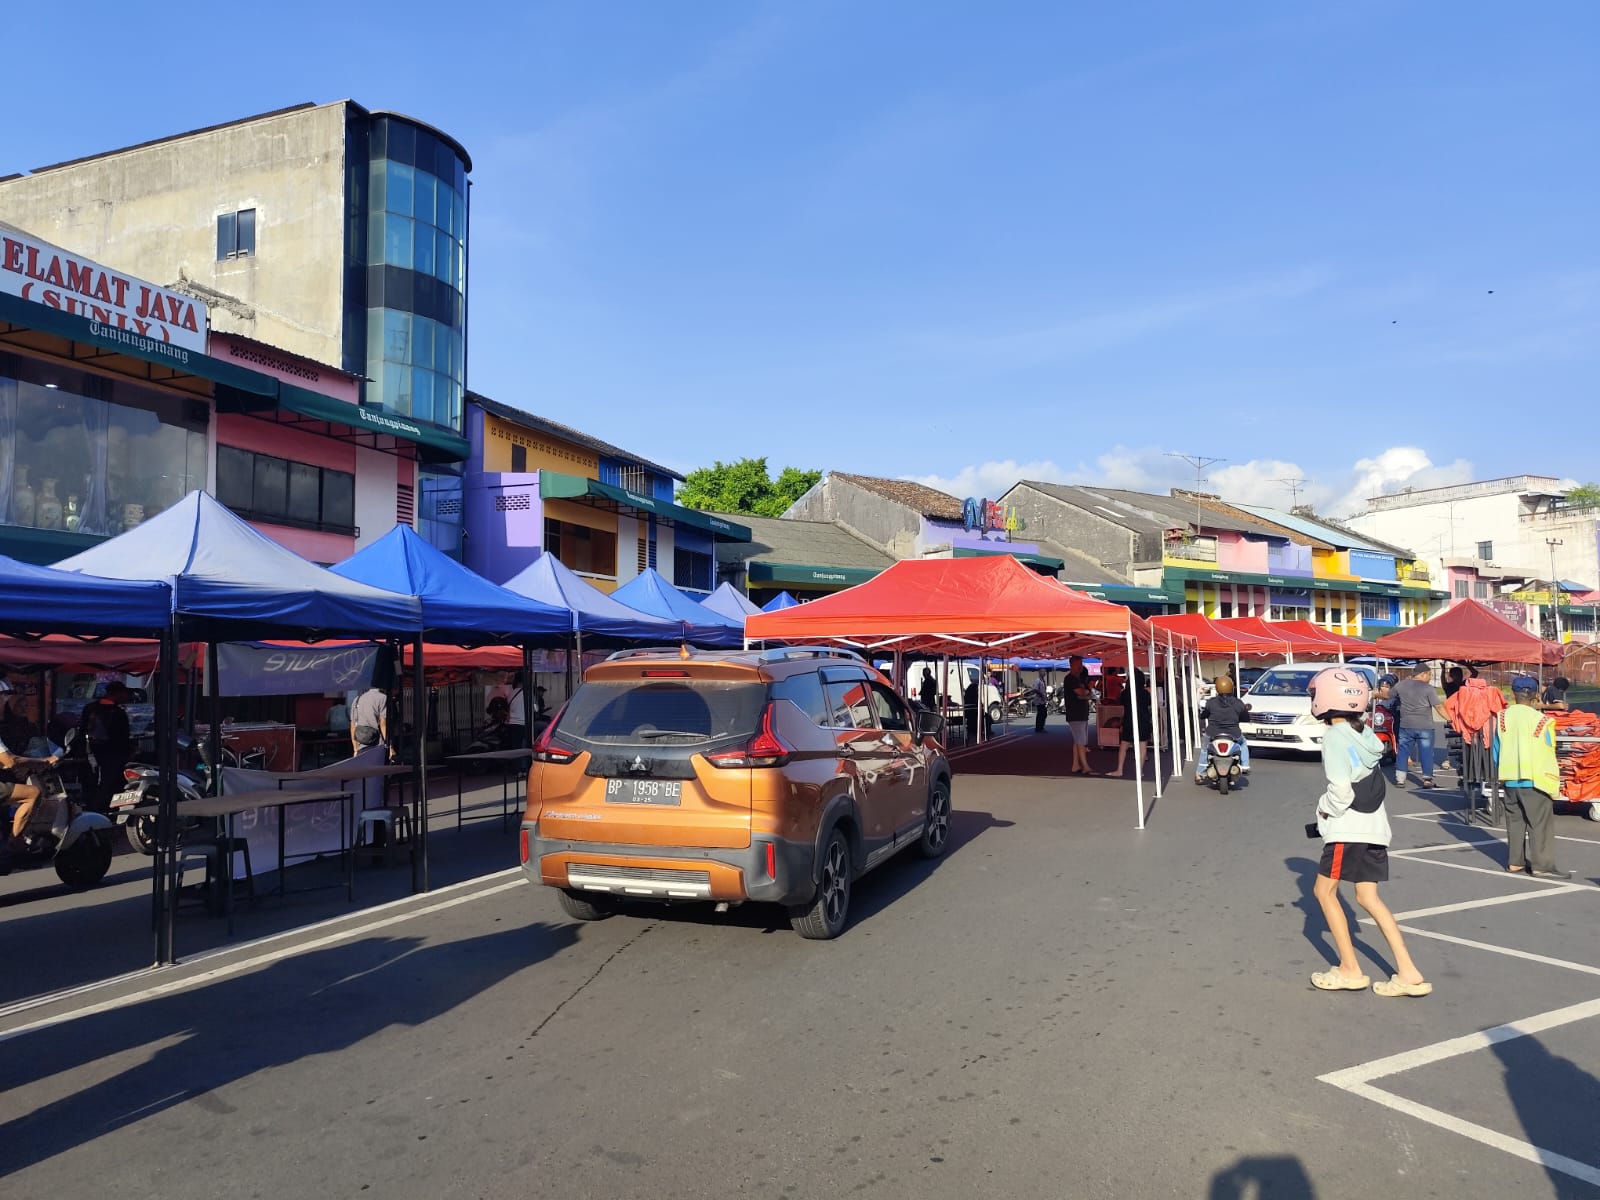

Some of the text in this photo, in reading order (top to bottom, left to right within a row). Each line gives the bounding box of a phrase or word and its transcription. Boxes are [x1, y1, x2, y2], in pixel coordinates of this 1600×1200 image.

[2, 237, 199, 333] ELAMAT JAYA
[89, 319, 189, 364] Tanjungpinang
[608, 780, 681, 797] BP 1958 BE
